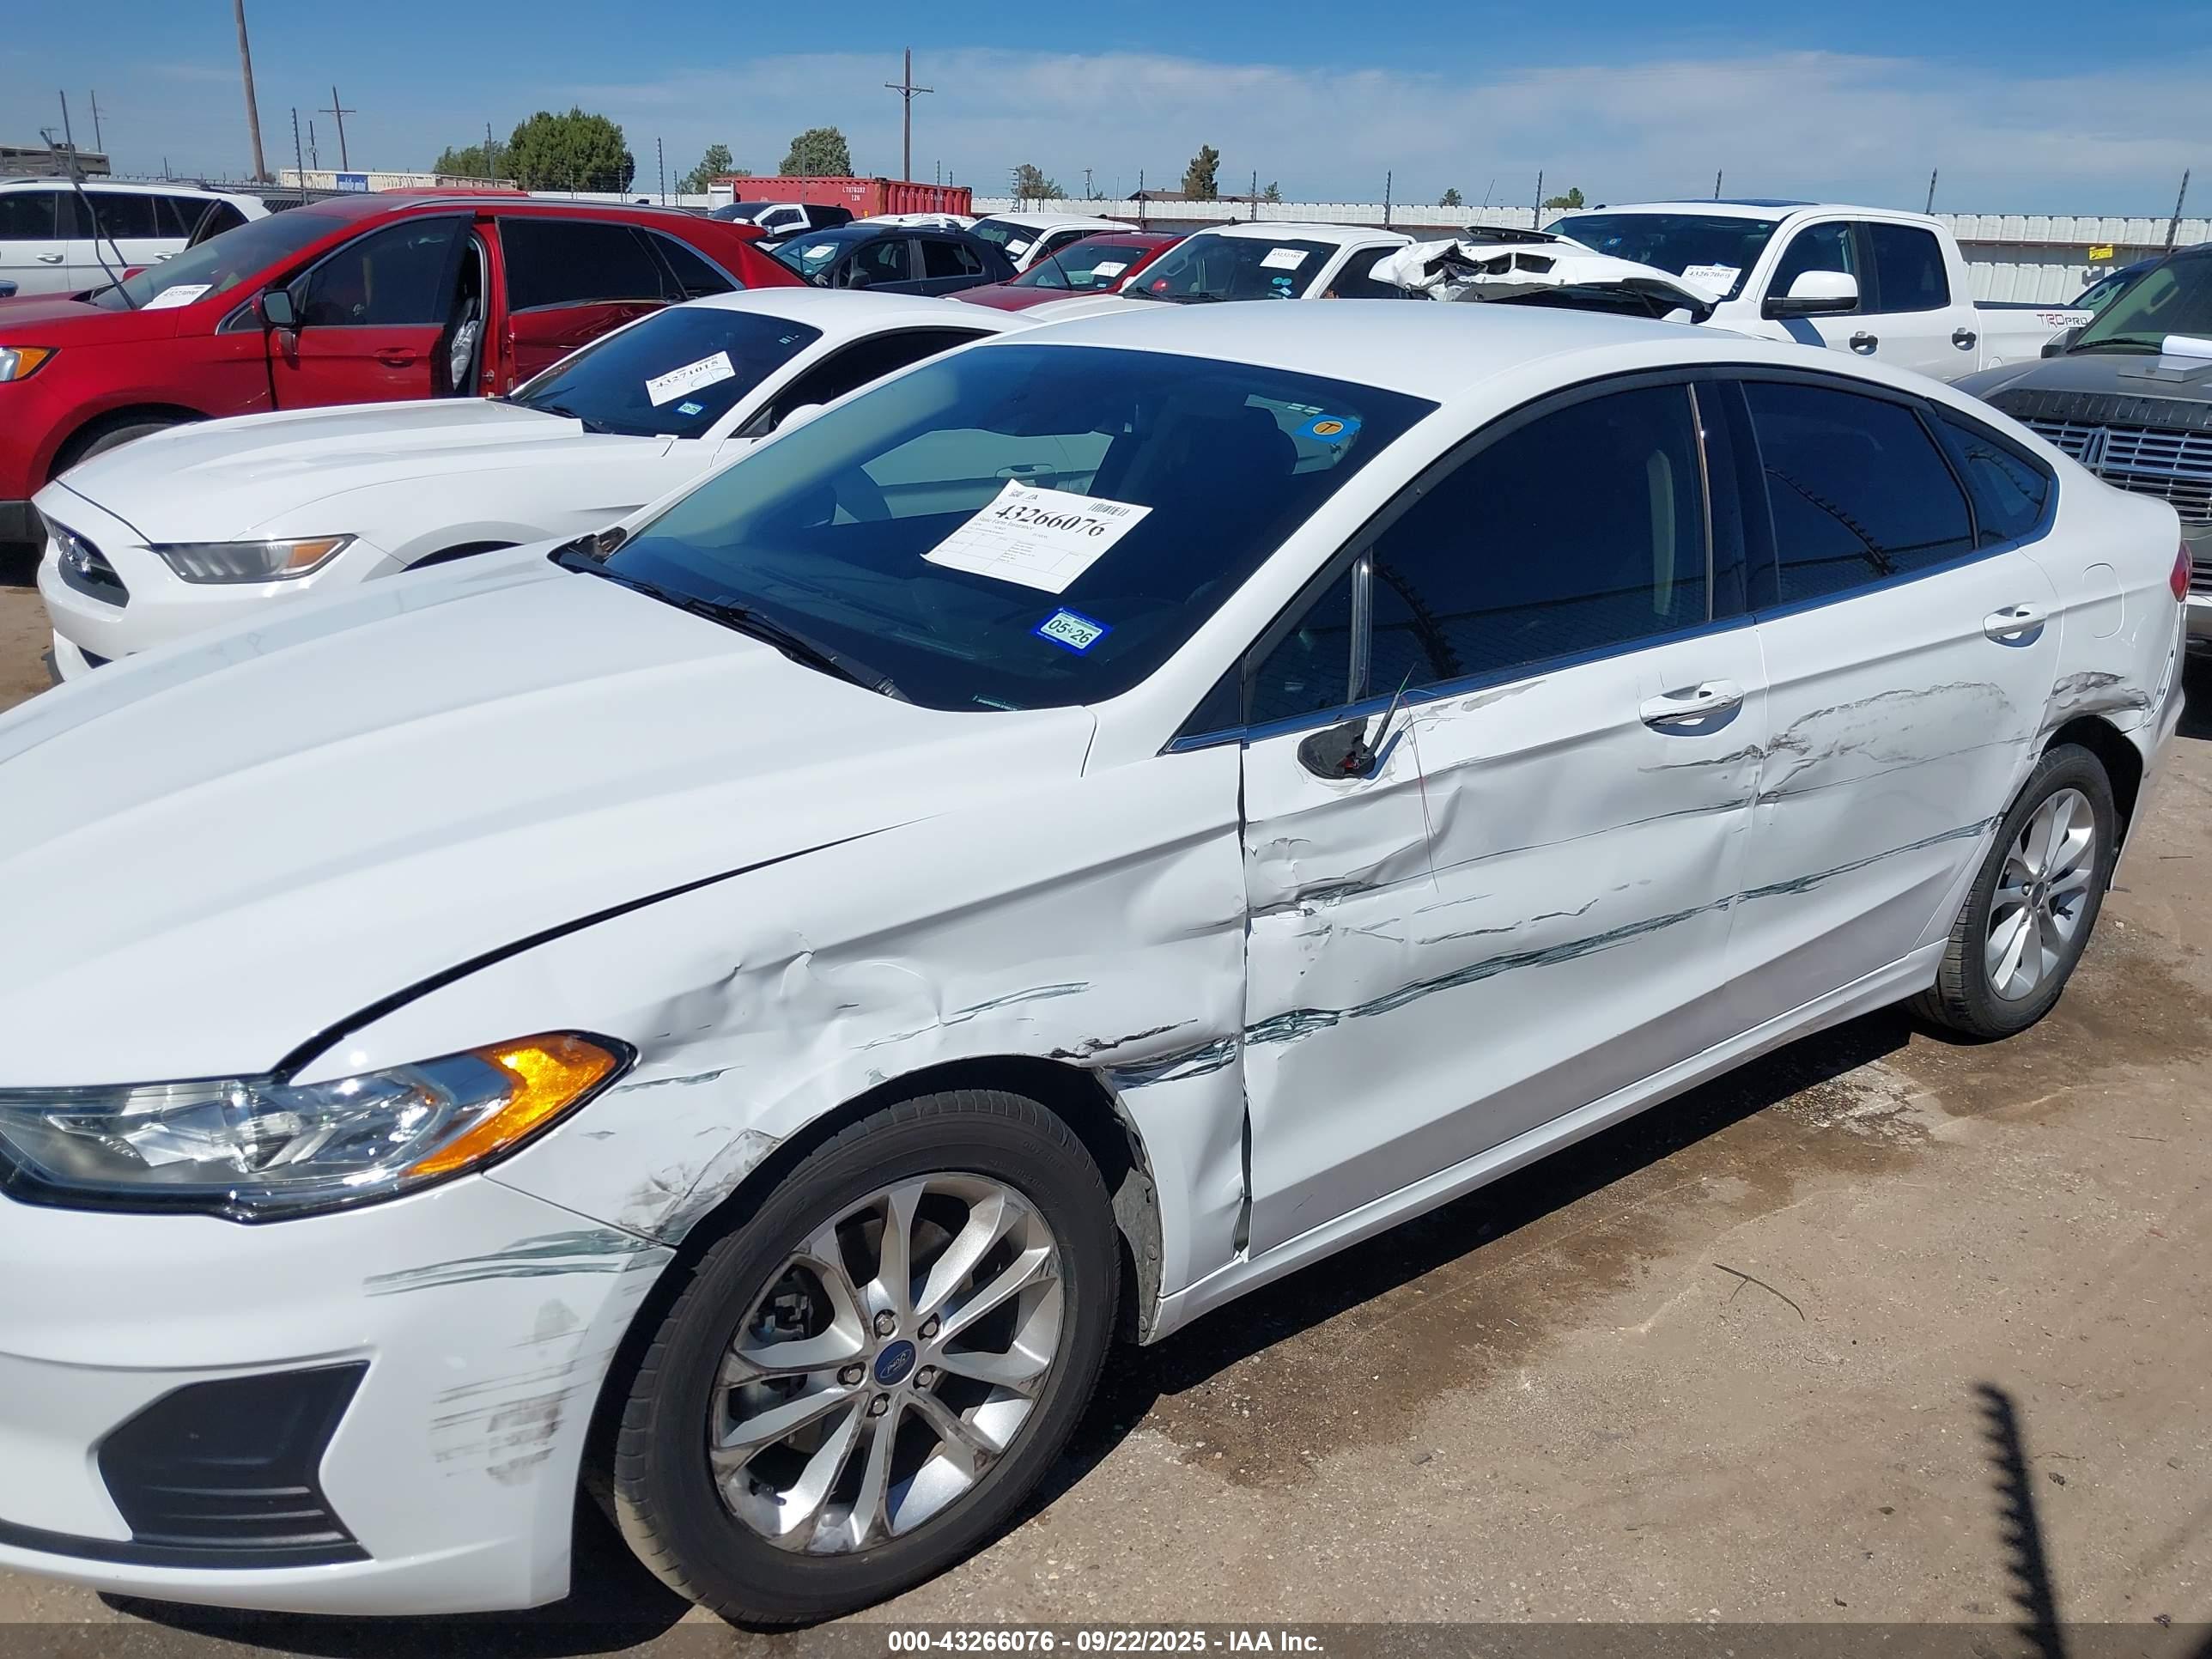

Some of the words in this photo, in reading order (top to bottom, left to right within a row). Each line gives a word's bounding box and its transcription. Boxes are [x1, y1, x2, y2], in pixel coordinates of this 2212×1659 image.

[2037, 313, 2065, 328] TRD
[2065, 317, 2088, 325] PRO
[995, 504, 1114, 537] 43266076
